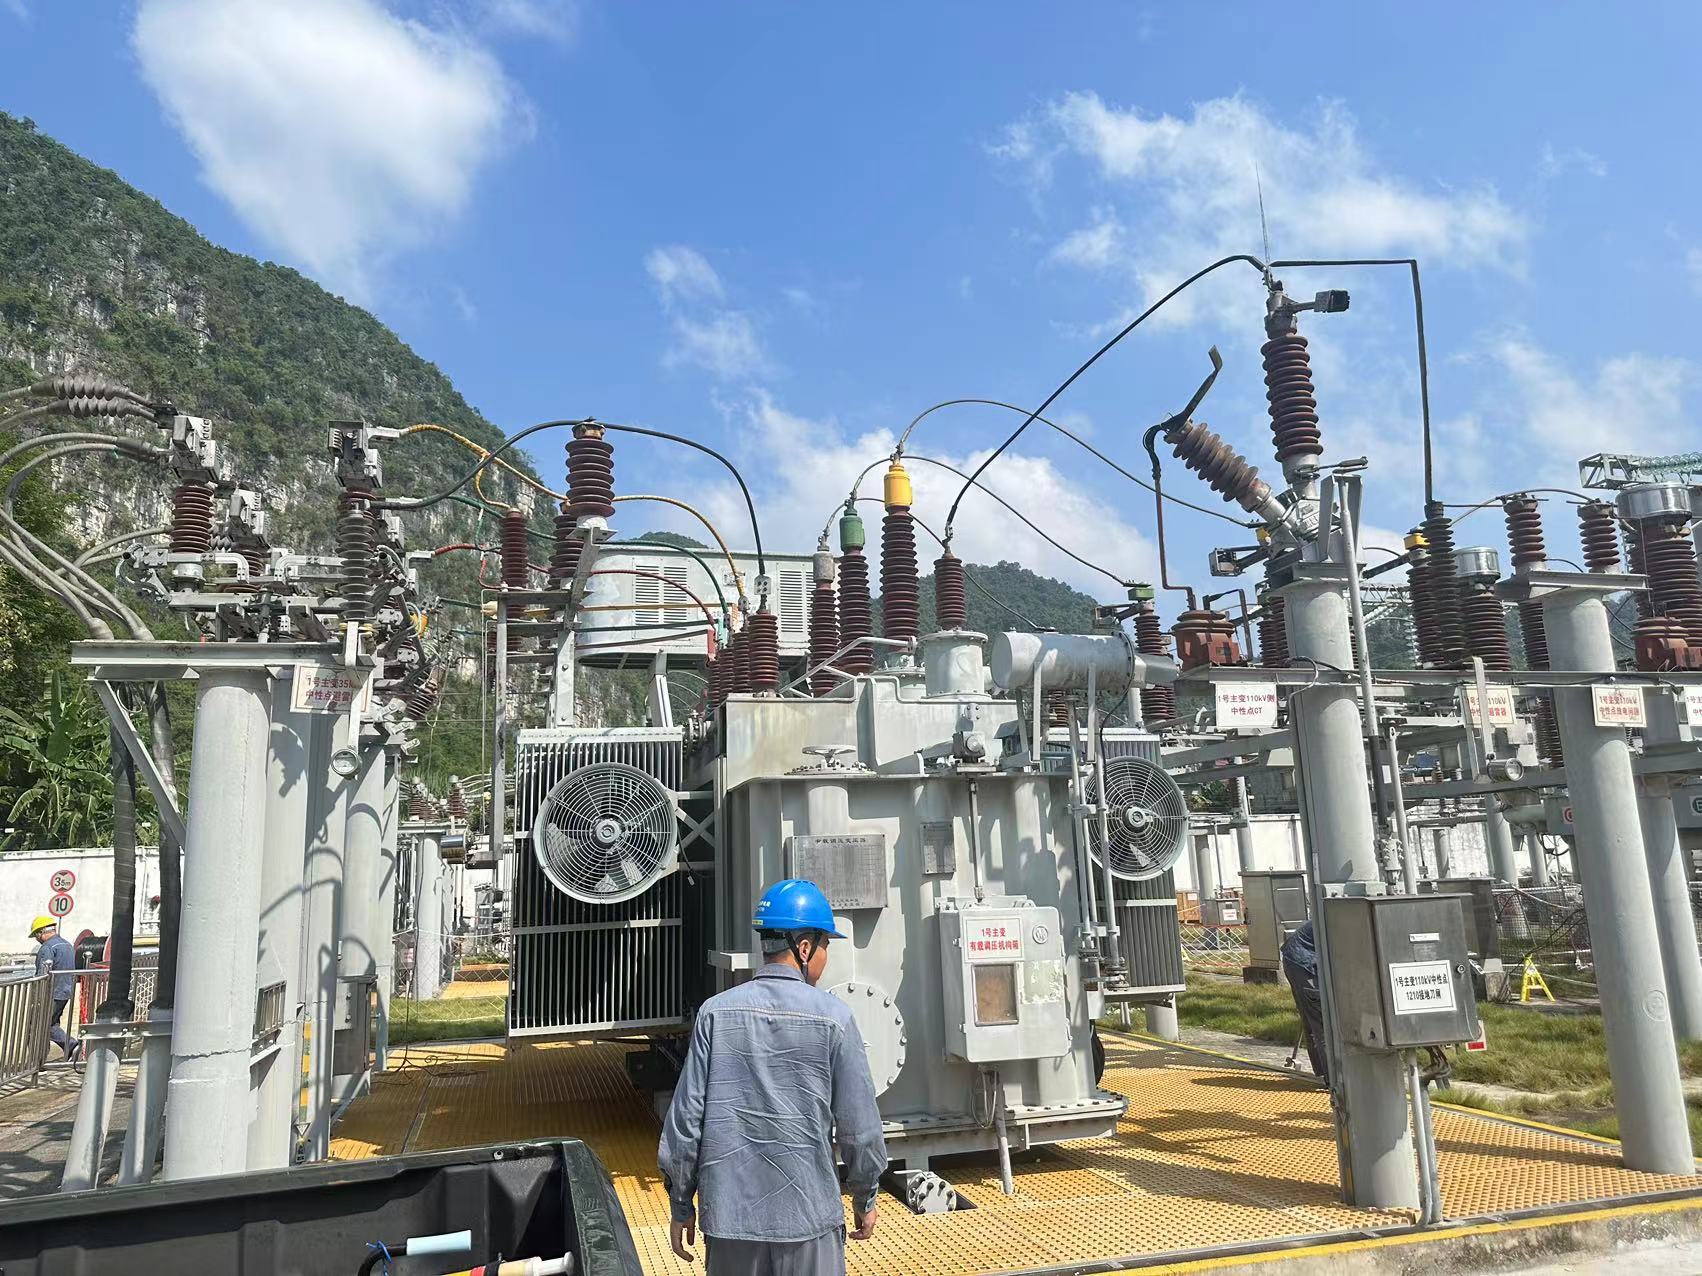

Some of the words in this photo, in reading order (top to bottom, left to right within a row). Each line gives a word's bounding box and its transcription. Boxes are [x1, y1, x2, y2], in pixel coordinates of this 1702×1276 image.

[306, 689, 352, 702] 中性点避雷
[1218, 695, 1275, 703] 1号主变110kV侧
[1231, 707, 1262, 715] 中性点CT
[1471, 708, 1507, 717] 中性避雷器
[55, 897, 68, 911] 10
[981, 927, 1007, 937] 1号主变
[970, 940, 1019, 951] 有载调压机构箱
[1395, 974, 1448, 987] 1号主变110kV中性点
